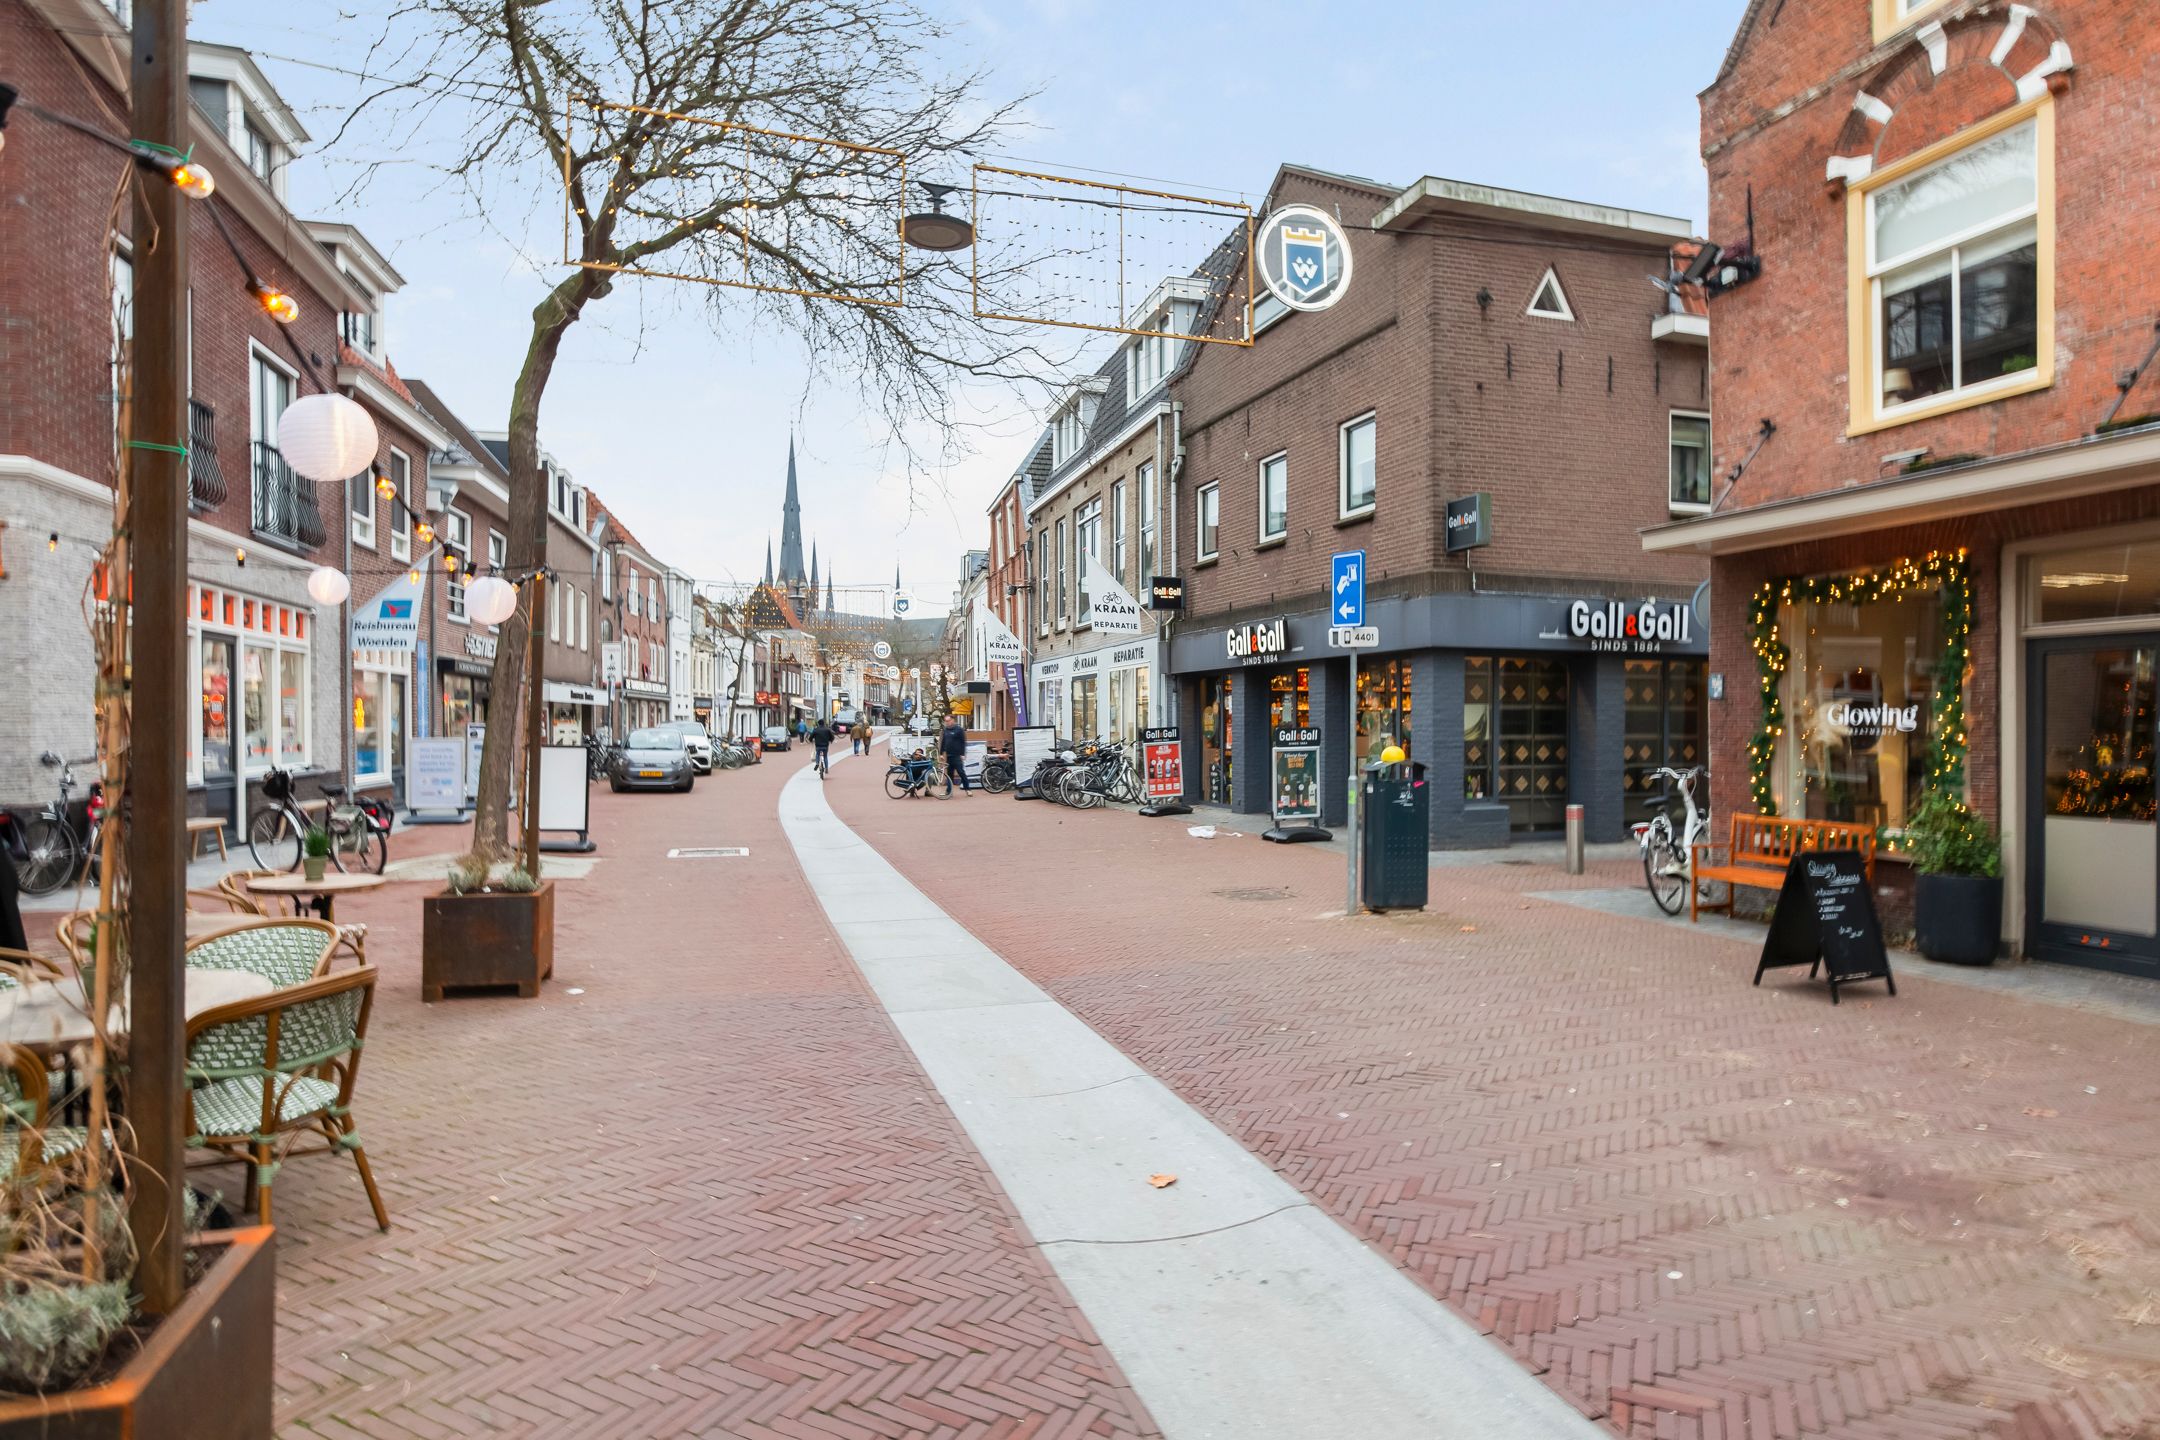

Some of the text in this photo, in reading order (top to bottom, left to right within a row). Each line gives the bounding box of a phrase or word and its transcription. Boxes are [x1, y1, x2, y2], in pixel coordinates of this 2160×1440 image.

[1094, 603, 1135, 615] KRAAN
[353, 619, 416, 632] Reisbureau
[1094, 620, 1138, 630] REPARATIE
[357, 635, 407, 648] Woerden
[1354, 633, 1374, 641] 4401
[989, 641, 1019, 650] KRAAN
[1591, 640, 1661, 653] SINDS 1884
[989, 653, 1019, 661] VERKOOP
[1113, 646, 1144, 663] REPARATIE
[1242, 654, 1278, 666] SINDS 1884
[1080, 655, 1098, 669] KRAAN
[1041, 663, 1059, 675] VERKOOP
[1827, 702, 1919, 732] Glowing
[1845, 727, 1898, 736] REATMENTS
